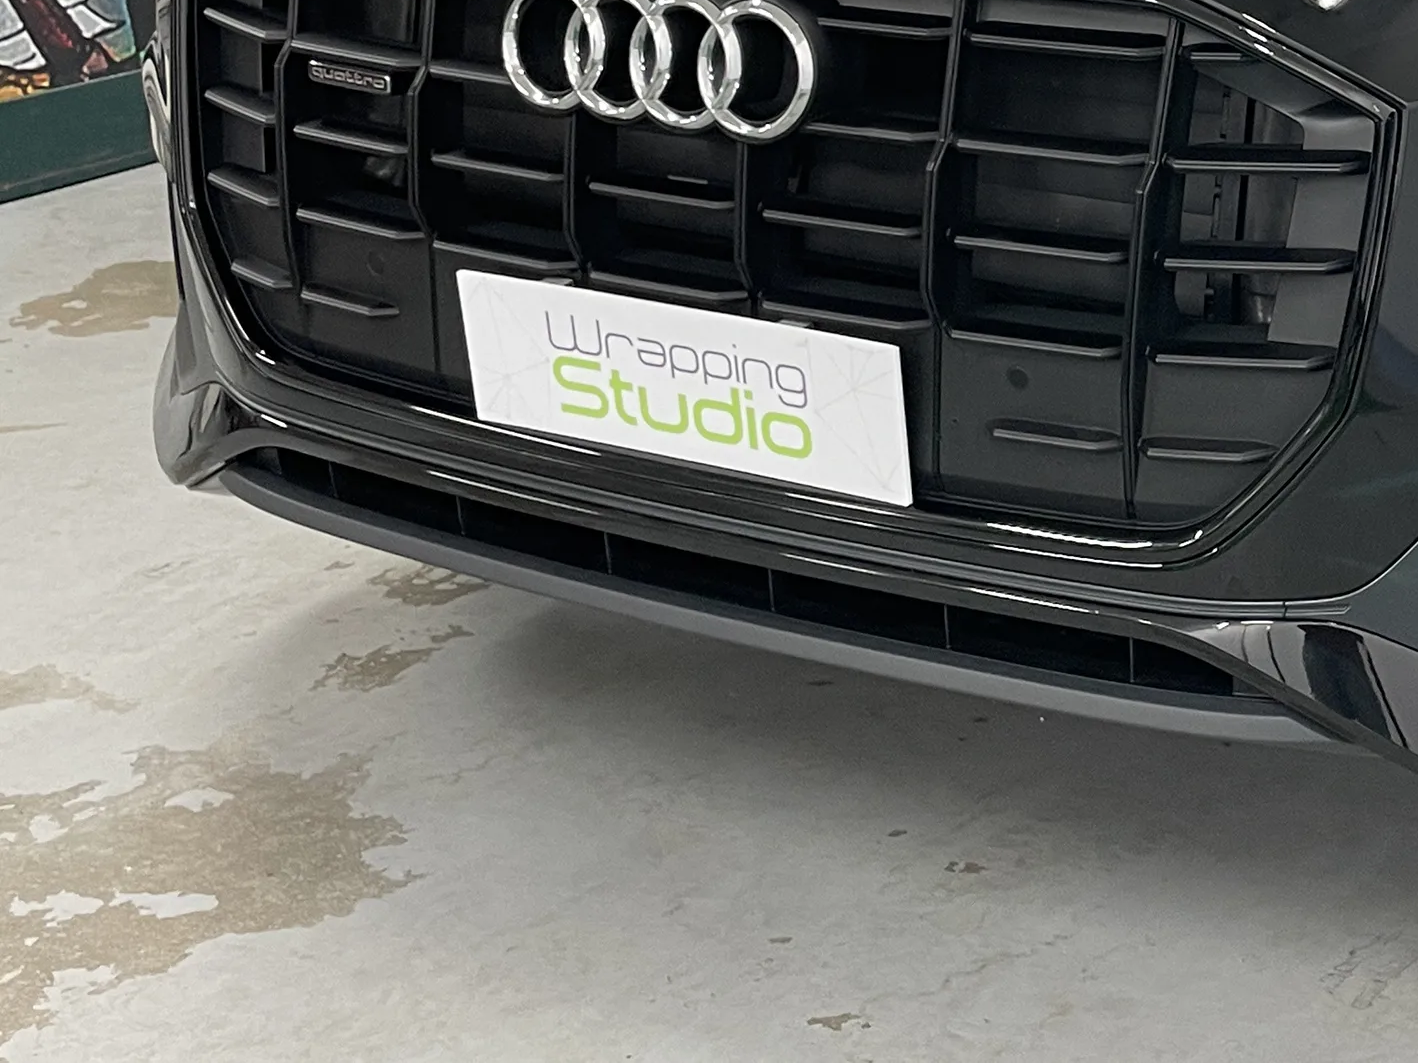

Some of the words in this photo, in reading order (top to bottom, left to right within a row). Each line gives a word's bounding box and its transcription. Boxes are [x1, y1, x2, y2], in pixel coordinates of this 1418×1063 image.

[311, 66, 385, 89] quattro
[544, 310, 809, 409] Wrapping
[553, 355, 813, 459] Studio
